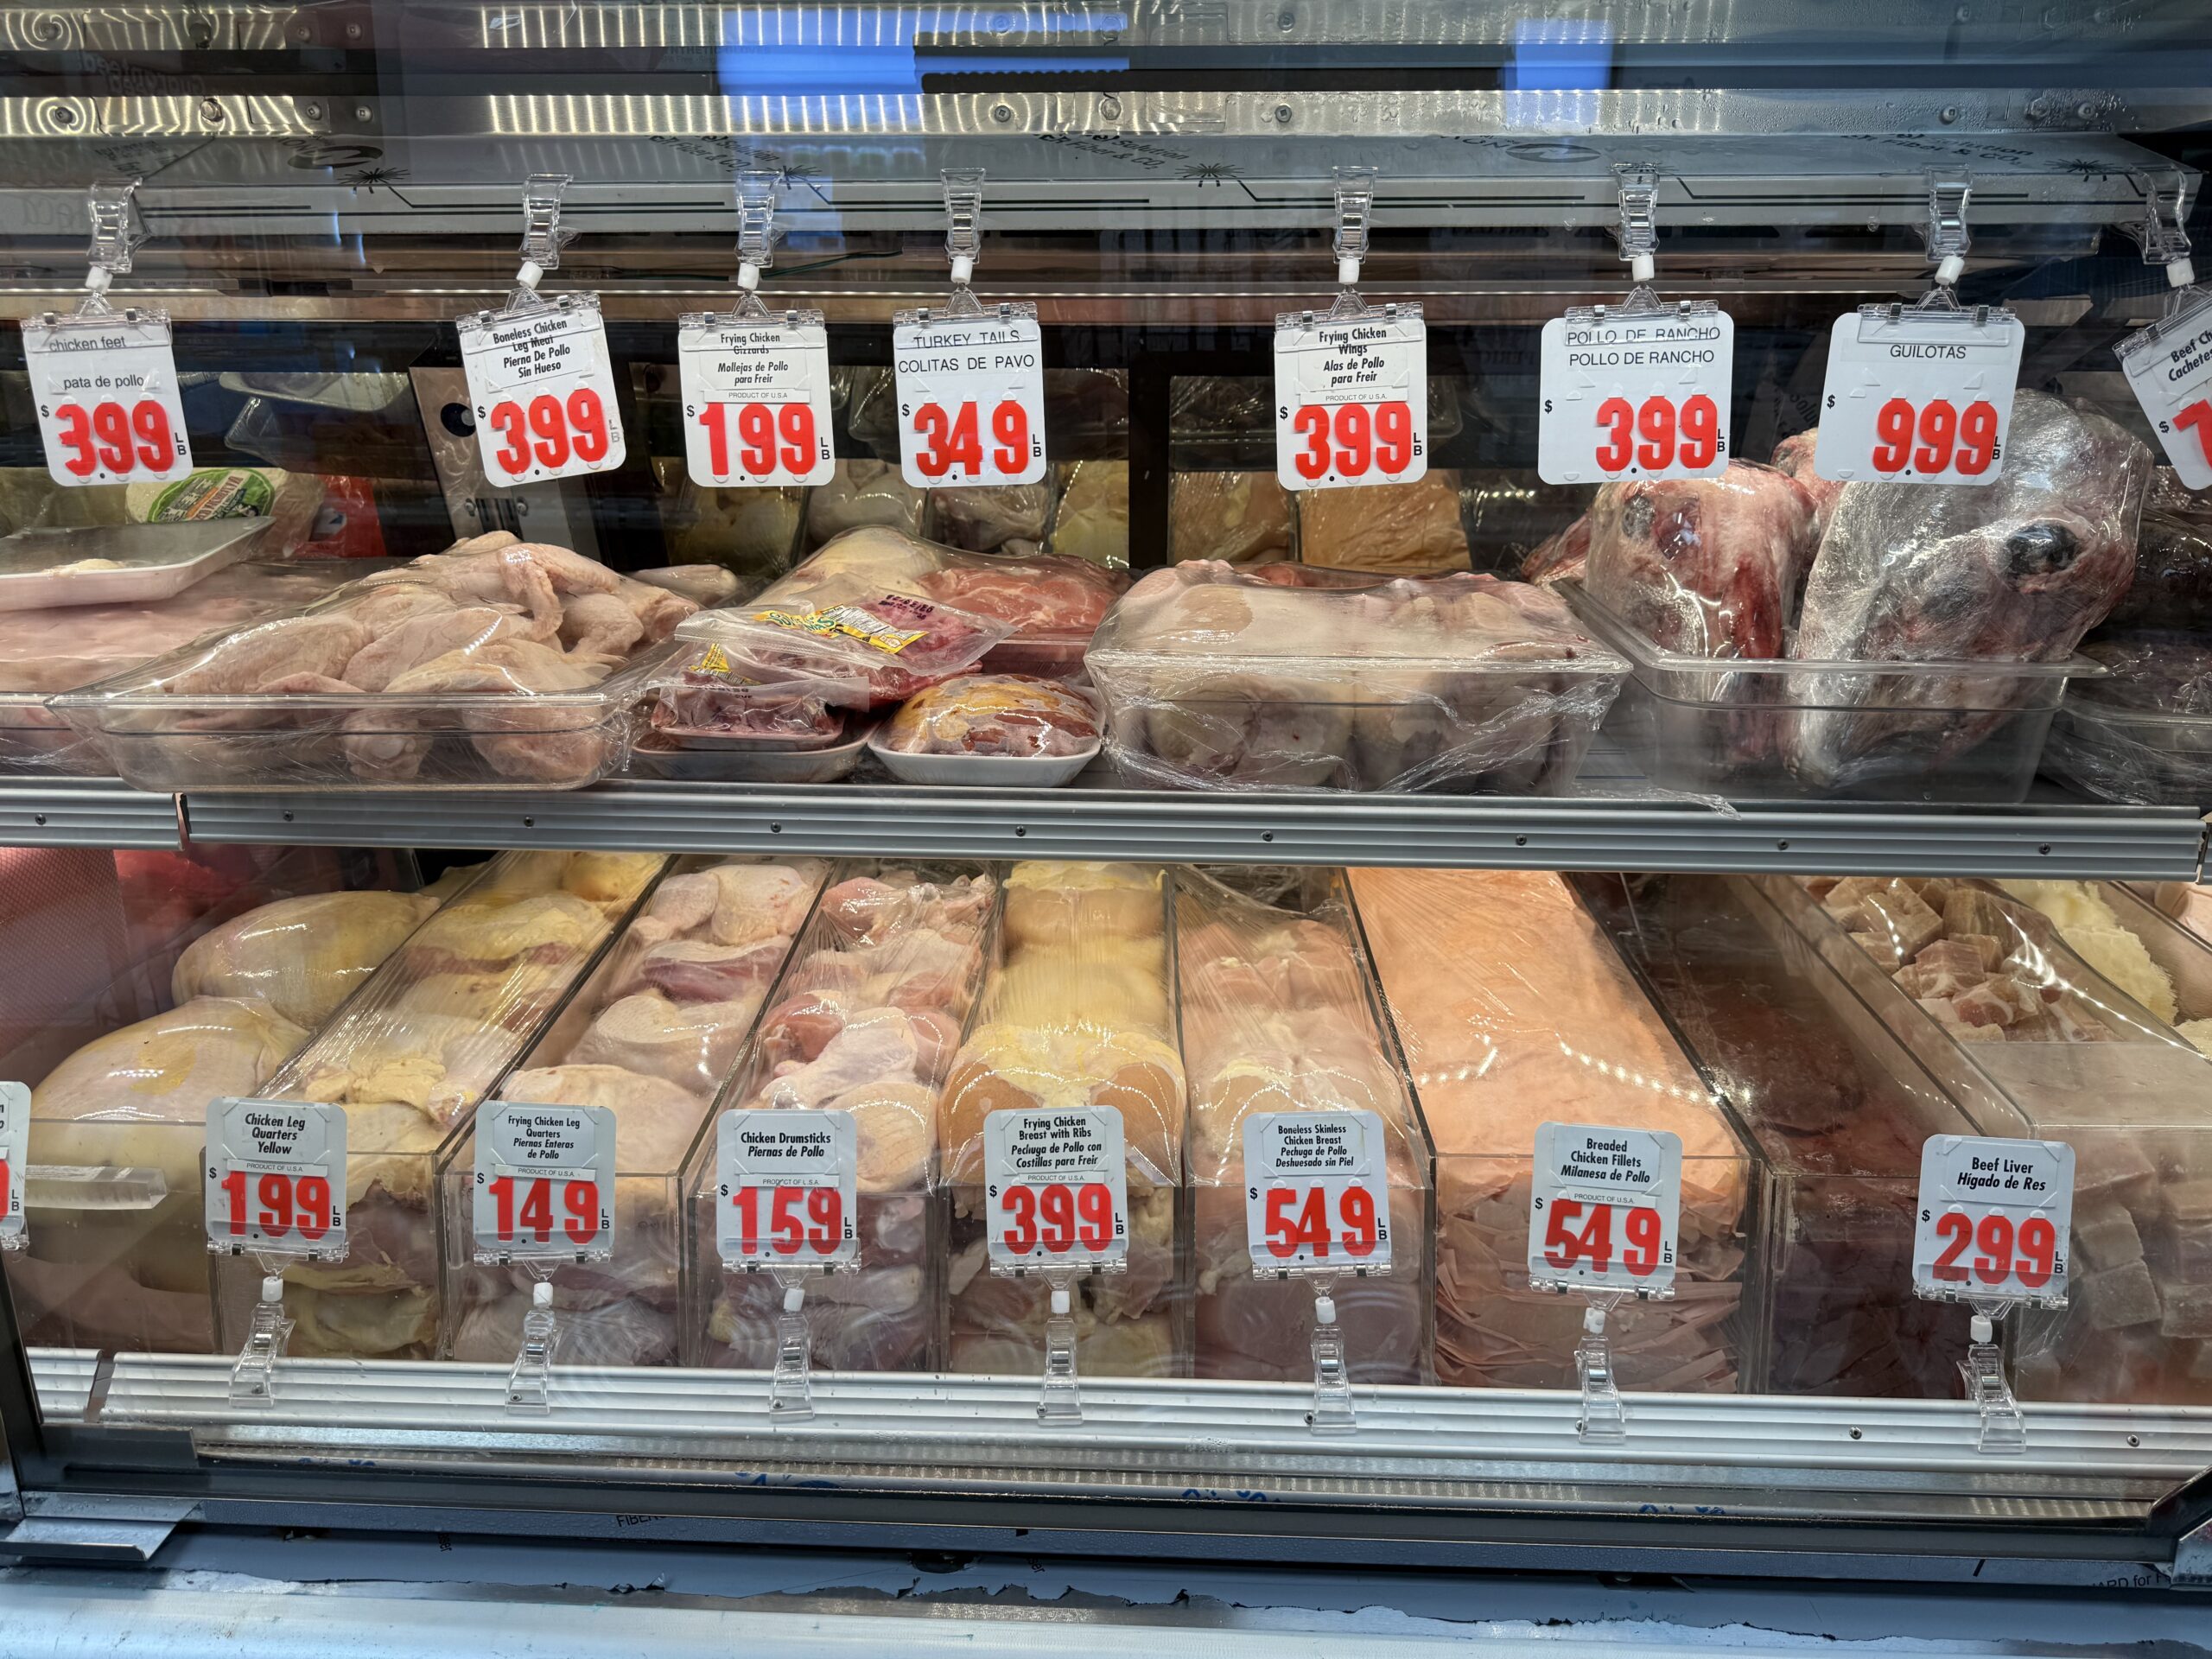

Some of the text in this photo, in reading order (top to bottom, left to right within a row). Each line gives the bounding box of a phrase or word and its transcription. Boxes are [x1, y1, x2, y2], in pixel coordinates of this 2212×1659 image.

[1066, 141, 1116, 156] Fiber
[1112, 140, 1189, 161] Solution
[493, 319, 568, 345] Boneless Chicken
[721, 332, 781, 346] Frying Chicken
[913, 329, 1020, 349] TURKEY TAILS
[1319, 327, 1387, 344] Frying Chicken
[1567, 327, 1721, 345] POLLO DE RANCHO
[49, 335, 126, 353] chicken feet
[512, 335, 555, 353] Leg Meat
[1338, 344, 1368, 357] Wings
[2171, 338, 2197, 364] Beef
[503, 344, 571, 369] Pierna De Pollo
[1569, 350, 1714, 366] POLLO DE RANCHO
[1890, 345, 1967, 359] GUILOTAS
[518, 360, 562, 378] Sin Hueso
[717, 360, 789, 374] Mollejas de Pollo
[898, 354, 1035, 373] COLITAS DE PAVO
[1323, 356, 1385, 372] Alas de Pollo
[64, 374, 144, 391] pata de pollo
[734, 374, 773, 386] para Freir
[1331, 371, 1378, 388] para Freir
[1544, 399, 1553, 414] $
[1827, 394, 1836, 410] $
[41, 404, 50, 419] $
[477, 405, 486, 420] $
[901, 404, 911, 417] $
[1280, 405, 1288, 420] $
[2158, 421, 2170, 434] $
[245, 1113, 306, 1131] Chicken Leg
[508, 1116, 581, 1129] Frying Chicken Leg
[1023, 1116, 1086, 1131] Frying Chicken
[1278, 1123, 1347, 1135] Boneless Skinless
[251, 1127, 297, 1141] Quarters
[525, 1128, 561, 1139] Quarters
[741, 1132, 831, 1144] Chicken Drumsticks
[1019, 1128, 1092, 1141] Breast with Ribs
[1283, 1135, 1342, 1146] Chicken Breast
[257, 1141, 293, 1154] Yellow
[513, 1137, 575, 1149] Piernas Enteras
[1011, 1141, 1102, 1156] Pechuga de Pollo con
[1586, 1137, 1628, 1153] Breaded
[527, 1149, 560, 1160] de Pollo
[747, 1146, 825, 1158] Piernas de Pollo
[1281, 1145, 1348, 1159] Pechuga de Pollo
[1570, 1150, 1642, 1167] Chicken Fillets
[246, 1162, 276, 1171] PRODUCT
[1015, 1154, 1098, 1170] Costillas para Freir
[1275, 1155, 1354, 1168] Deshuesado sin Piel
[1971, 1157, 2034, 1174] Beef Liver
[208, 1166, 218, 1180] $
[1560, 1164, 1650, 1184] Milanesa de Pollo
[1957, 1172, 2046, 1191] Hígado de Res
[720, 1184, 728, 1198] $
[988, 1185, 998, 1198] $
[1249, 1186, 1258, 1201] $
[1573, 1192, 1605, 1201] PRODUCT
[1535, 1197, 1543, 1211] $
[1921, 1209, 1930, 1223] $
[2133, 1574, 2152, 1588] for
